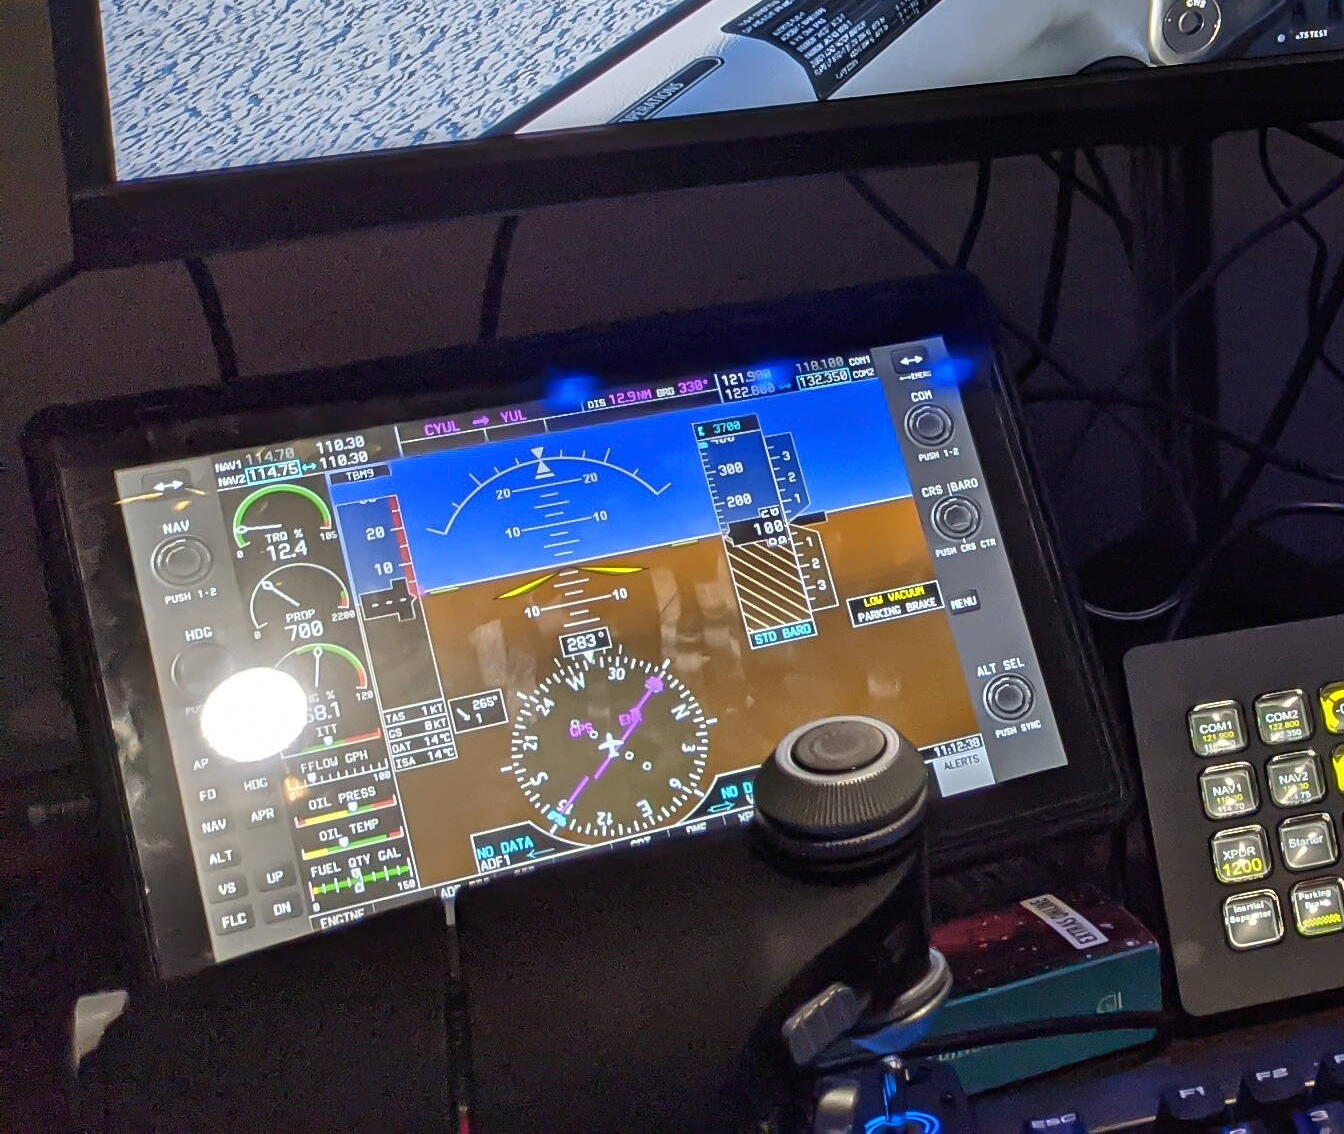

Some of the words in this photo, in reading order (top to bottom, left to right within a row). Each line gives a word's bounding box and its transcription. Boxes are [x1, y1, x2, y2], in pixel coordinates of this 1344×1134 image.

[799, 369, 849, 387] 132.350
[852, 367, 874, 379] COM2
[656, 385, 675, 398] BRG
[678, 378, 709, 394] 330°
[911, 390, 933, 403] COM
[424, 419, 461, 437] CYUL
[500, 409, 527, 424] YUL
[218, 473, 246, 486] NAV2
[249, 462, 299, 480] 114.75
[320, 450, 369, 469] 110.30
[718, 462, 744, 476] 300
[922, 484, 944, 498] CRS
[266, 540, 307, 562] 12.4
[864, 593, 885, 607] LOW
[888, 585, 925, 603] VACUUM
[951, 594, 977, 609] MENU
[857, 605, 902, 623] PARKING
[906, 596, 937, 614] BRAKE
[284, 621, 324, 641] 700
[754, 628, 778, 645] STD
[782, 622, 812, 639] BARO
[1266, 710, 1299, 725] COM2
[1200, 721, 1233, 736] COM1
[943, 754, 980, 772] ALERTS
[307, 796, 333, 811] OIL
[338, 785, 377, 803] PRESS
[1212, 784, 1242, 797] NAV1
[208, 849, 233, 865] ALT
[310, 862, 340, 878] FUEL
[348, 854, 373, 870] QTY
[377, 846, 402, 862] GAL
[1222, 856, 1262, 877] 1200
[1056, 917, 1098, 944] EXTRAS
